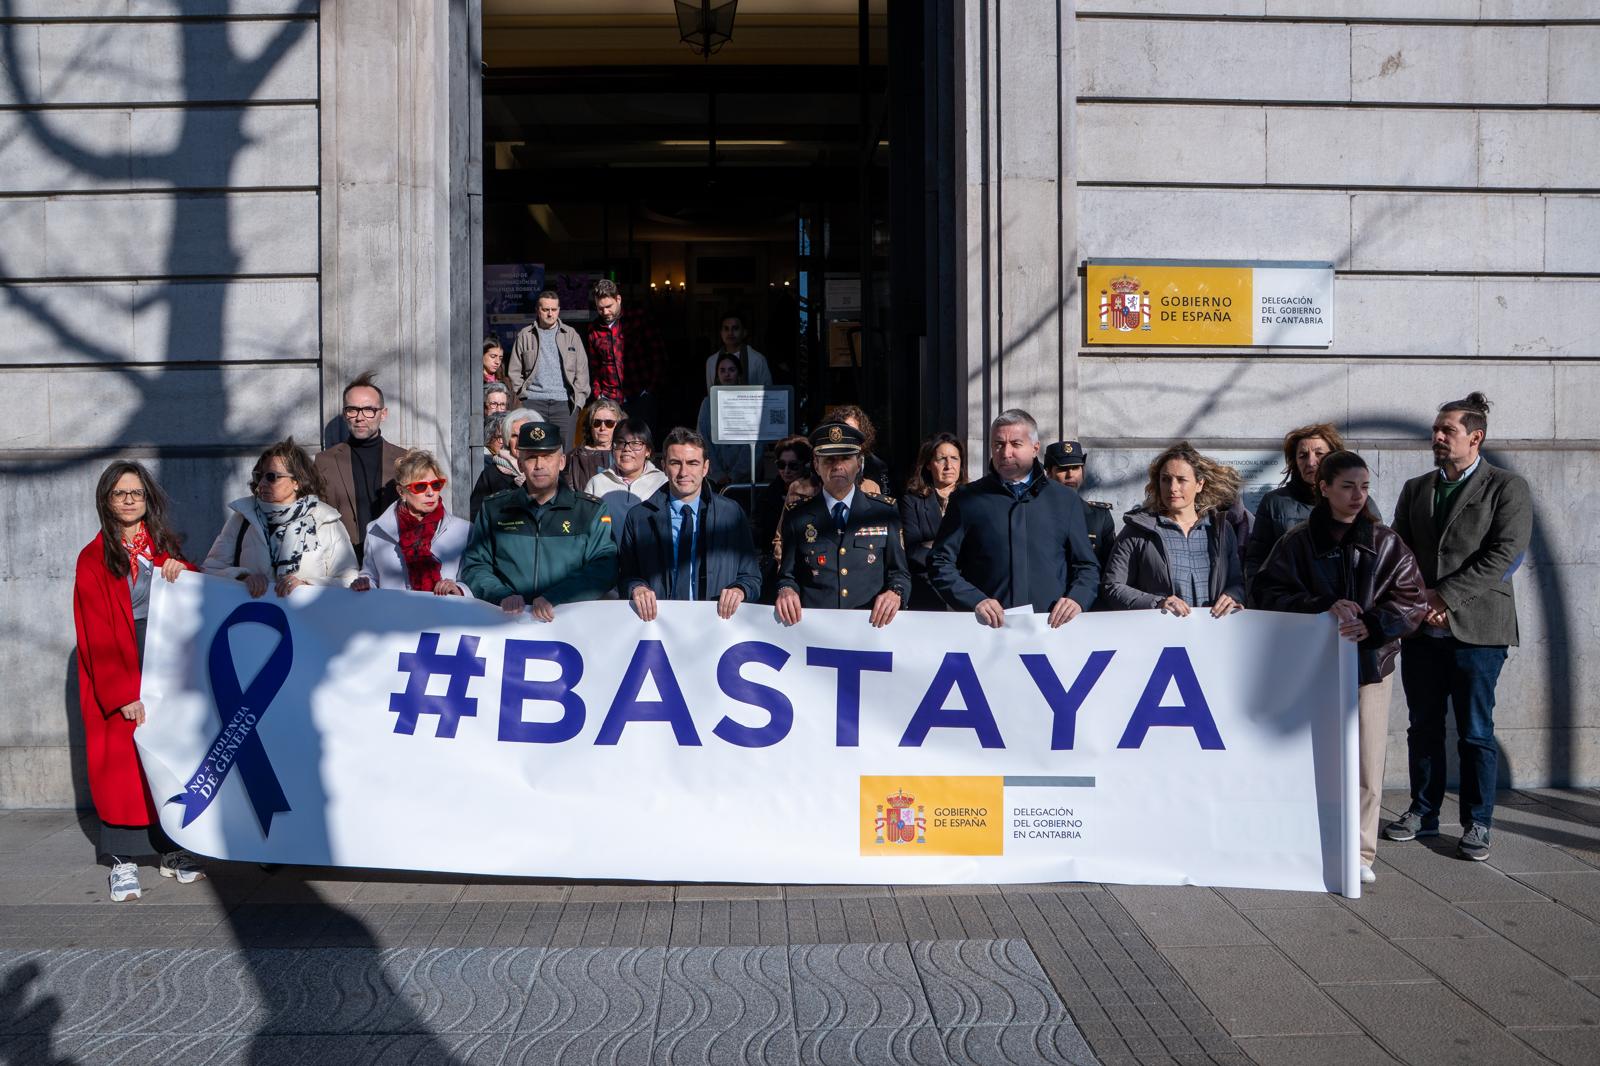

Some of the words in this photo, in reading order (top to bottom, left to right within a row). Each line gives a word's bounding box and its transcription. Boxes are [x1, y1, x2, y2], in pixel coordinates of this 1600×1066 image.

[1161, 296, 1232, 307] GOBIERNO
[1261, 296, 1313, 305] DELEGACIÓN
[1161, 311, 1177, 322] DE
[1182, 309, 1232, 322] ESPAÑA
[1261, 306, 1277, 315] DEL
[1279, 306, 1322, 315] GOBIERNO
[1261, 316, 1273, 324] EN
[1275, 316, 1324, 325] CANTABRIA
[388, 632, 1226, 751] #BASTAYA
[190, 774, 205, 794] NO
[208, 706, 250, 763] VIOLENCIA
[200, 774, 219, 800] DE
[934, 807, 988, 817] GOBIERNO
[1013, 806, 1074, 816] DELEGACIÓN
[934, 818, 947, 828] DE
[950, 816, 987, 828] ESPAÑA
[1013, 819, 1031, 828] DEL
[1033, 819, 1083, 828] GOBIERNO
[1013, 830, 1026, 839] EN
[1028, 830, 1082, 839] CANTABRIA
